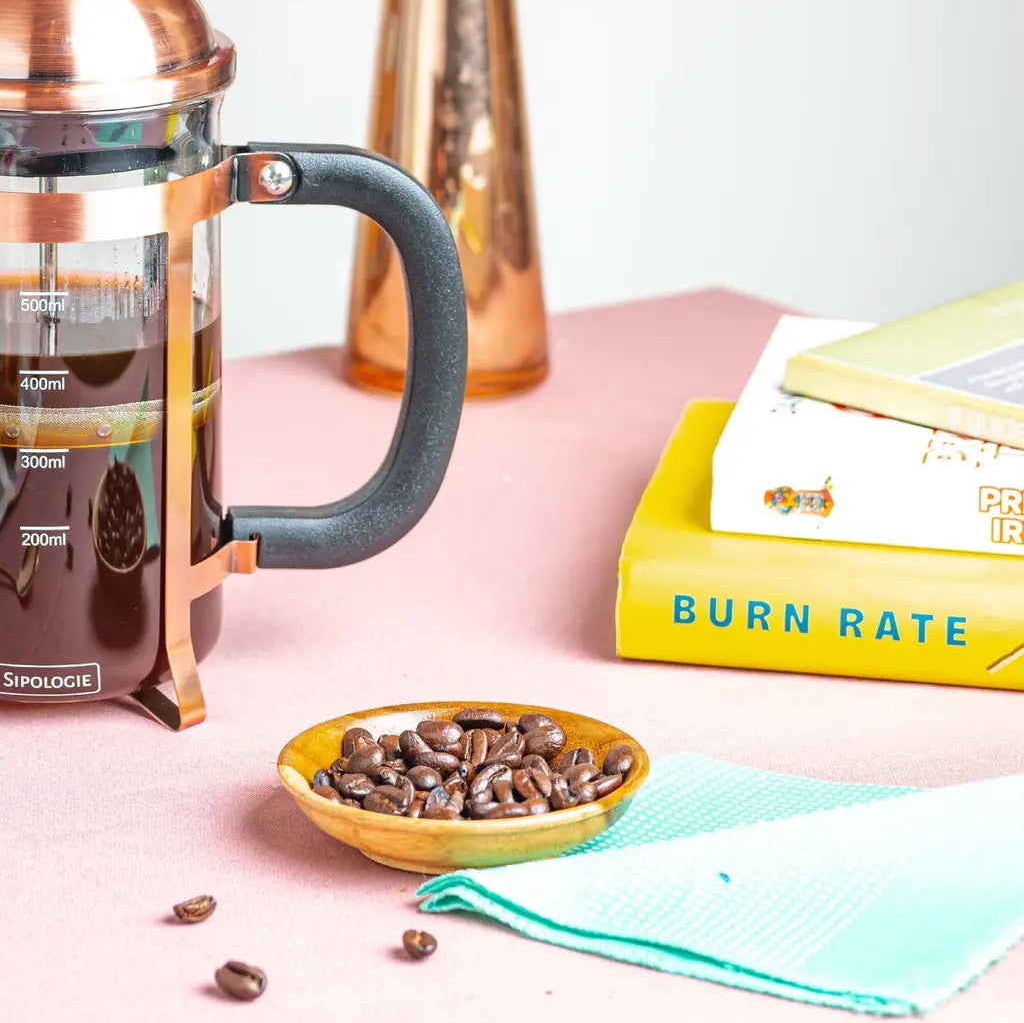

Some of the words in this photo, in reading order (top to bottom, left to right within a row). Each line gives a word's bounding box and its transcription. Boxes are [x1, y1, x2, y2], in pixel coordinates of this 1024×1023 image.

[20, 298, 65, 312] 500ml
[19, 376, 66, 391] 400ml
[20, 454, 66, 469] 300ml
[978, 485, 1024, 516] PR
[20, 532, 67, 547] 200ml
[673, 594, 811, 635] BURN
[839, 608, 968, 647] RATE
[2, 671, 93, 689] SIPOLOGIE
